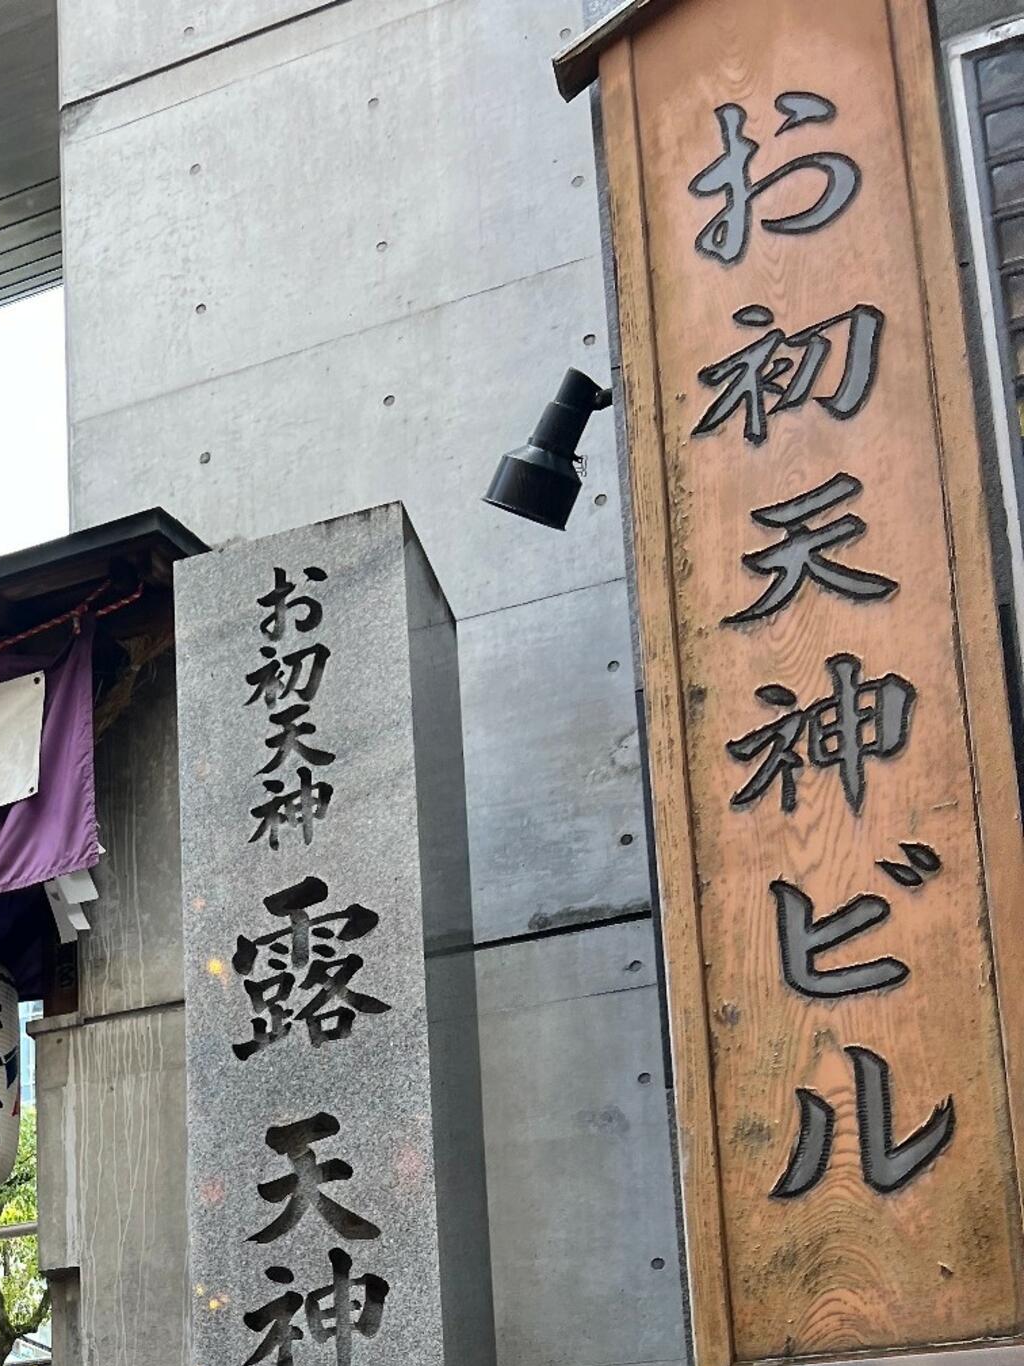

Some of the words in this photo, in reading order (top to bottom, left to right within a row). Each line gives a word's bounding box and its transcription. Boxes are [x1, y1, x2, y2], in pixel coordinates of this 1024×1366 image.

[243, 566, 336, 852] お初天神
[691, 93, 957, 1201] お初天神ビル
